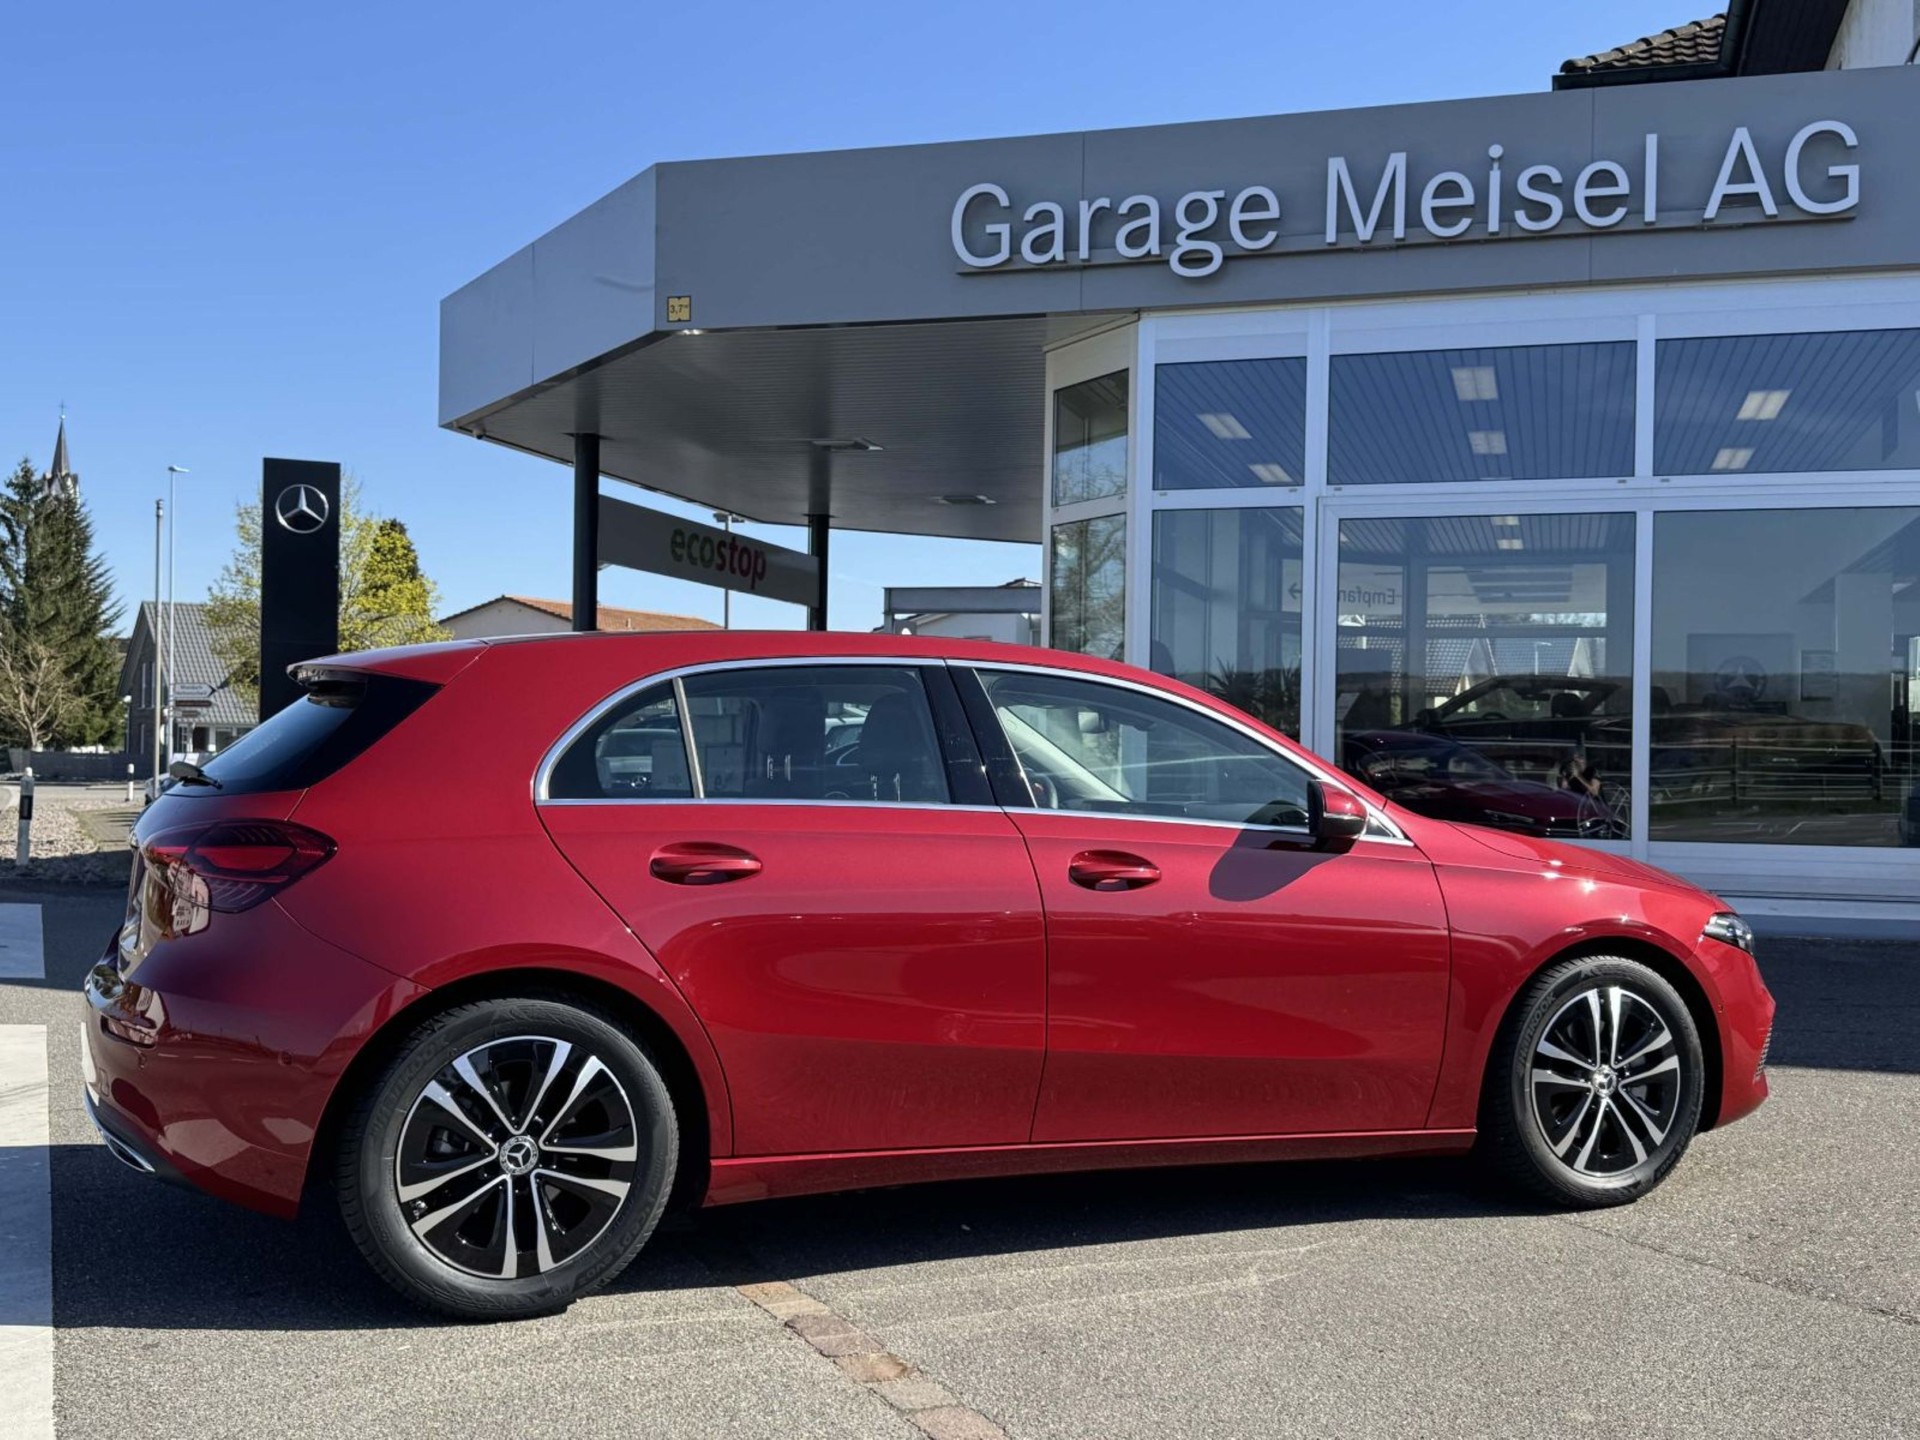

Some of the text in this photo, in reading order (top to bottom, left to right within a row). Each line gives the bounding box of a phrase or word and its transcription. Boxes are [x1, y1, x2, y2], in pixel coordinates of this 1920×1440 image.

[951, 119, 1861, 277] Garage Meisel AG
[670, 528, 766, 590] ecostop
